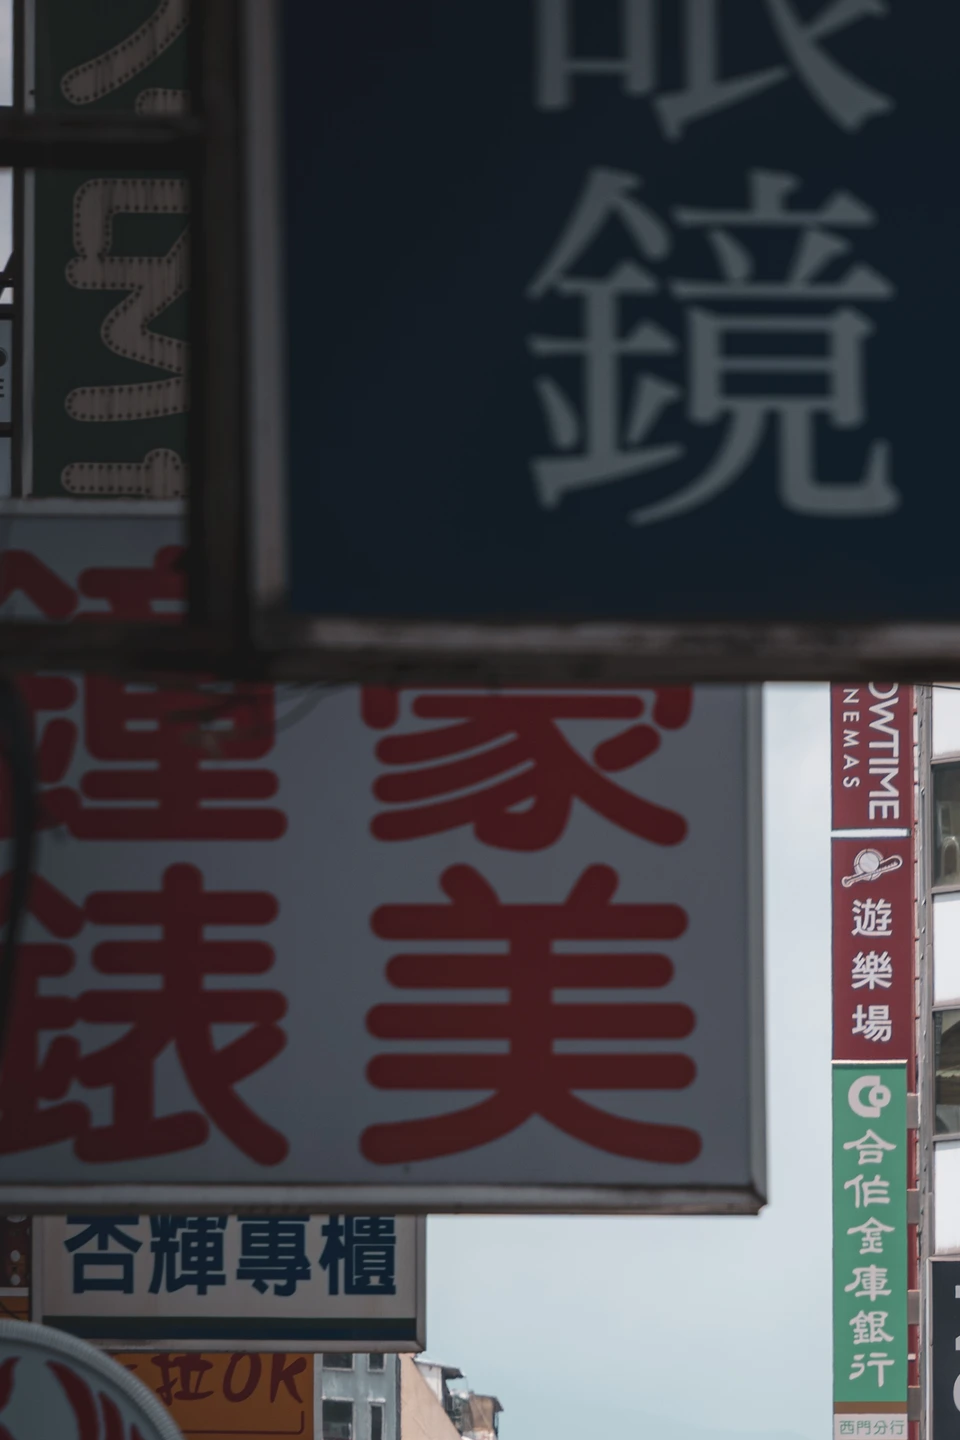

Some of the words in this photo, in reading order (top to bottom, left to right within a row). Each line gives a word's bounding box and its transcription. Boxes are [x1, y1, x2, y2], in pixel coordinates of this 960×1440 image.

[851, 898, 893, 1043] 遊樂場
[843, 1129, 897, 1388] 合作金庫銀行
[123, 1353, 308, 1406] 拉OK
[839, 1419, 905, 1436] 西門分行
